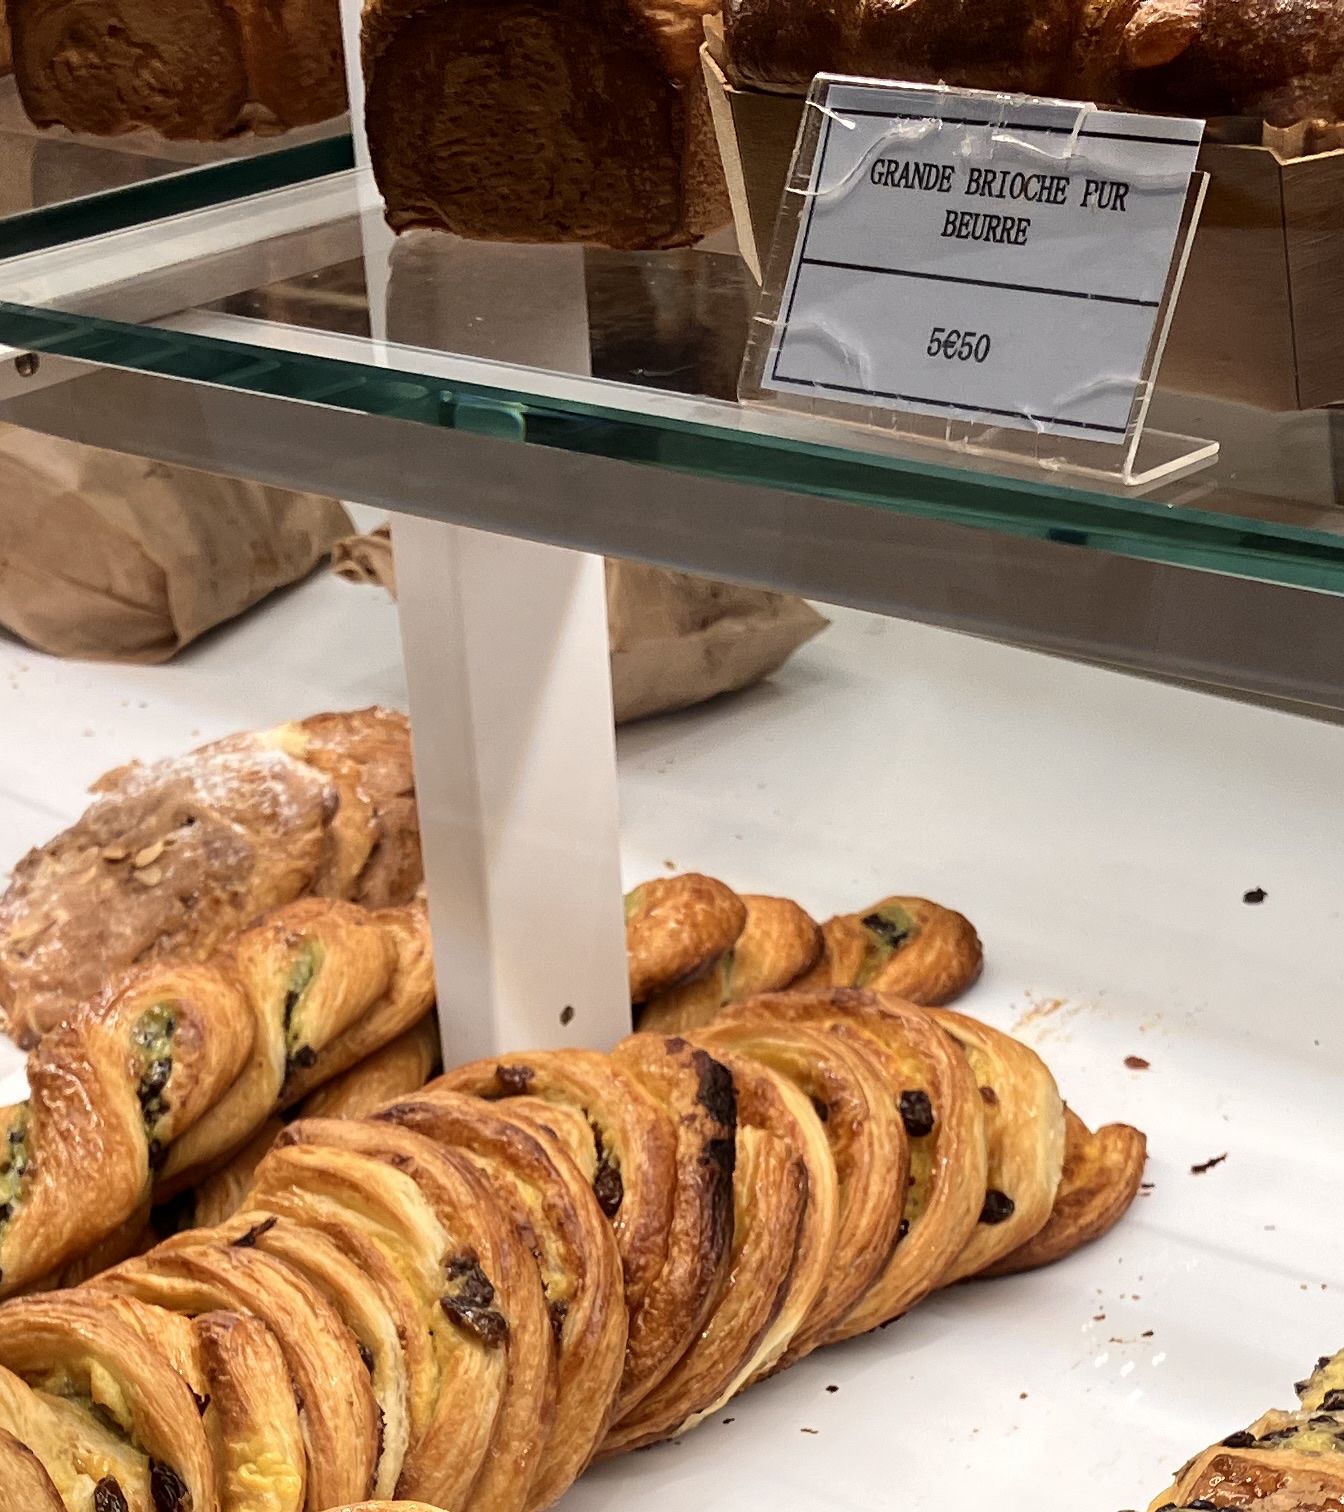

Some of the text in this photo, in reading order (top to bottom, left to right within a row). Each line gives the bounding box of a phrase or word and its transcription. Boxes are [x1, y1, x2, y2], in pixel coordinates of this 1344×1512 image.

[869, 158, 1130, 212] GRANDE BRIOCHE PUR
[940, 209, 1031, 246] BEURRE
[926, 327, 991, 363] 5€50
